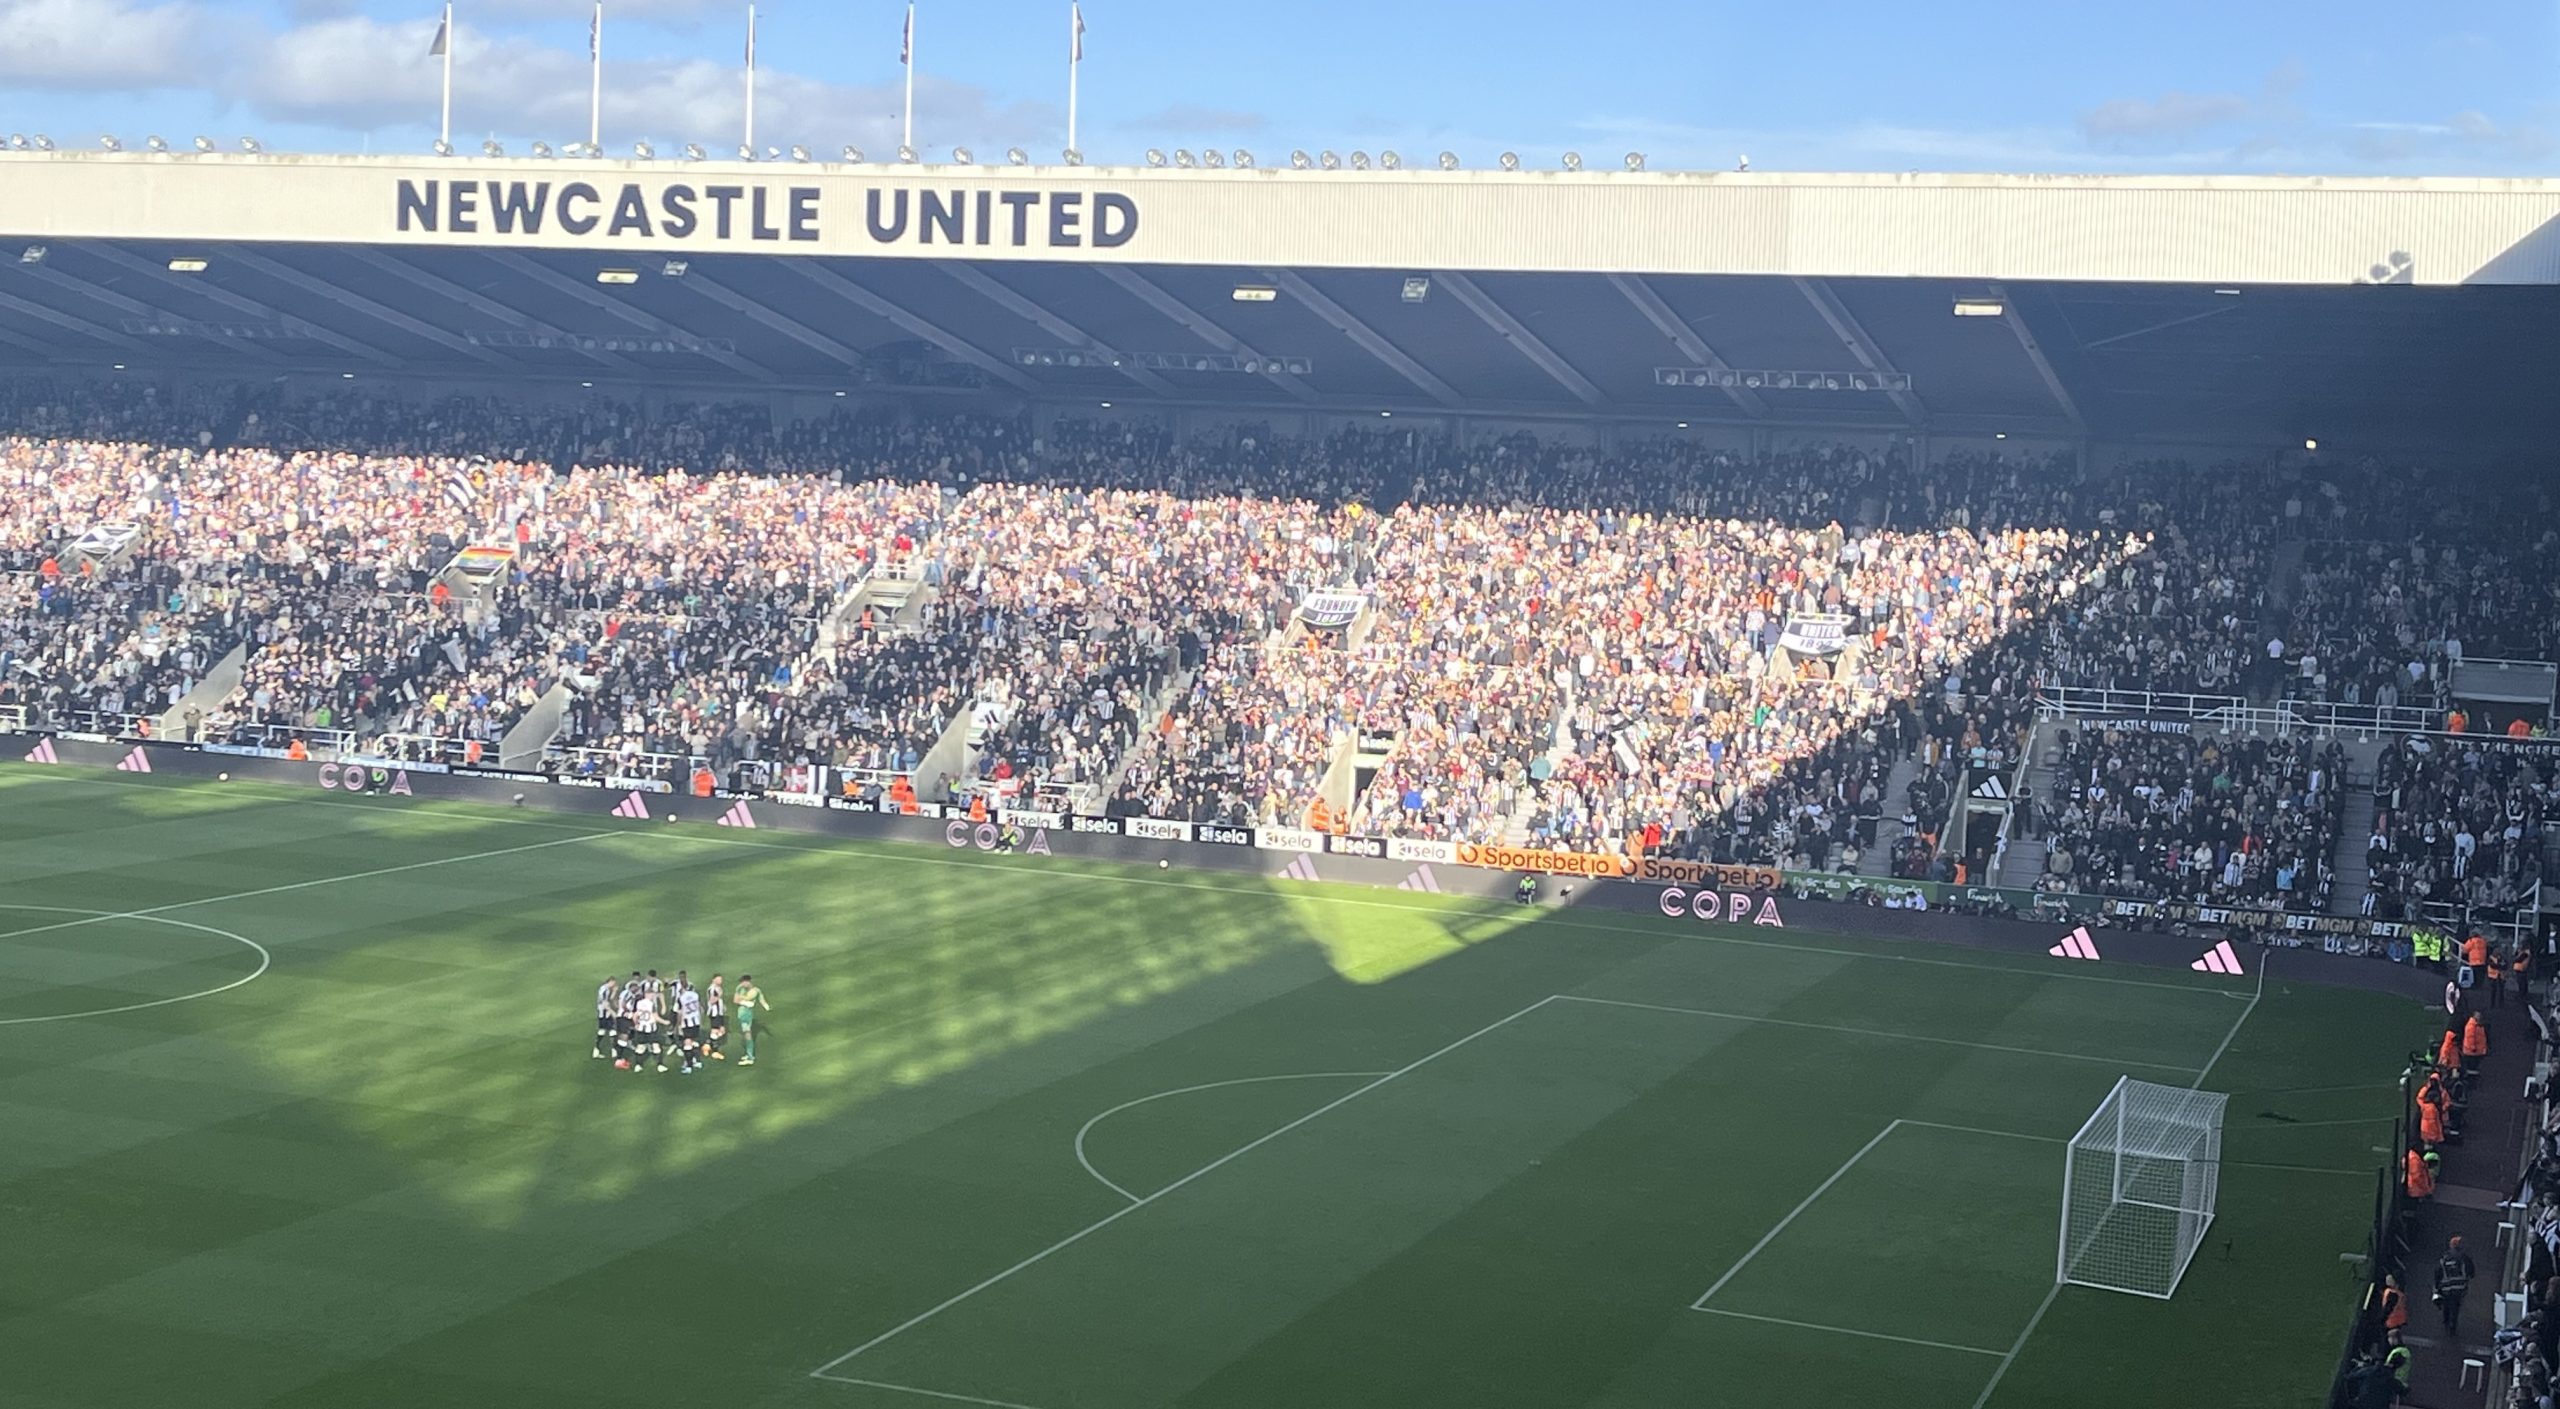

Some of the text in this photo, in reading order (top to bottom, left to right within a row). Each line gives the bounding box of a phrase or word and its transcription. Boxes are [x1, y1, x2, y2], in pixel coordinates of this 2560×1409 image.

[398, 179, 1139, 248] NEWCASTLE UNITED
[1021, 812, 1050, 829] sela
[1086, 816, 1119, 835] sela
[1151, 823, 1182, 840] sela
[1214, 830, 1248, 845] sela
[1279, 834, 1312, 850] sela
[1345, 838, 1381, 856] sela
[1413, 844, 1447, 860] sela
[1483, 846, 1610, 874] Sportsbet.io
[1643, 859, 1775, 888] Sportbet.io
[1659, 886, 1784, 928] COPA
[2115, 901, 2182, 920] BETMM
[2199, 908, 2267, 926] BETMGM
[2285, 915, 2354, 933] BETMGM
